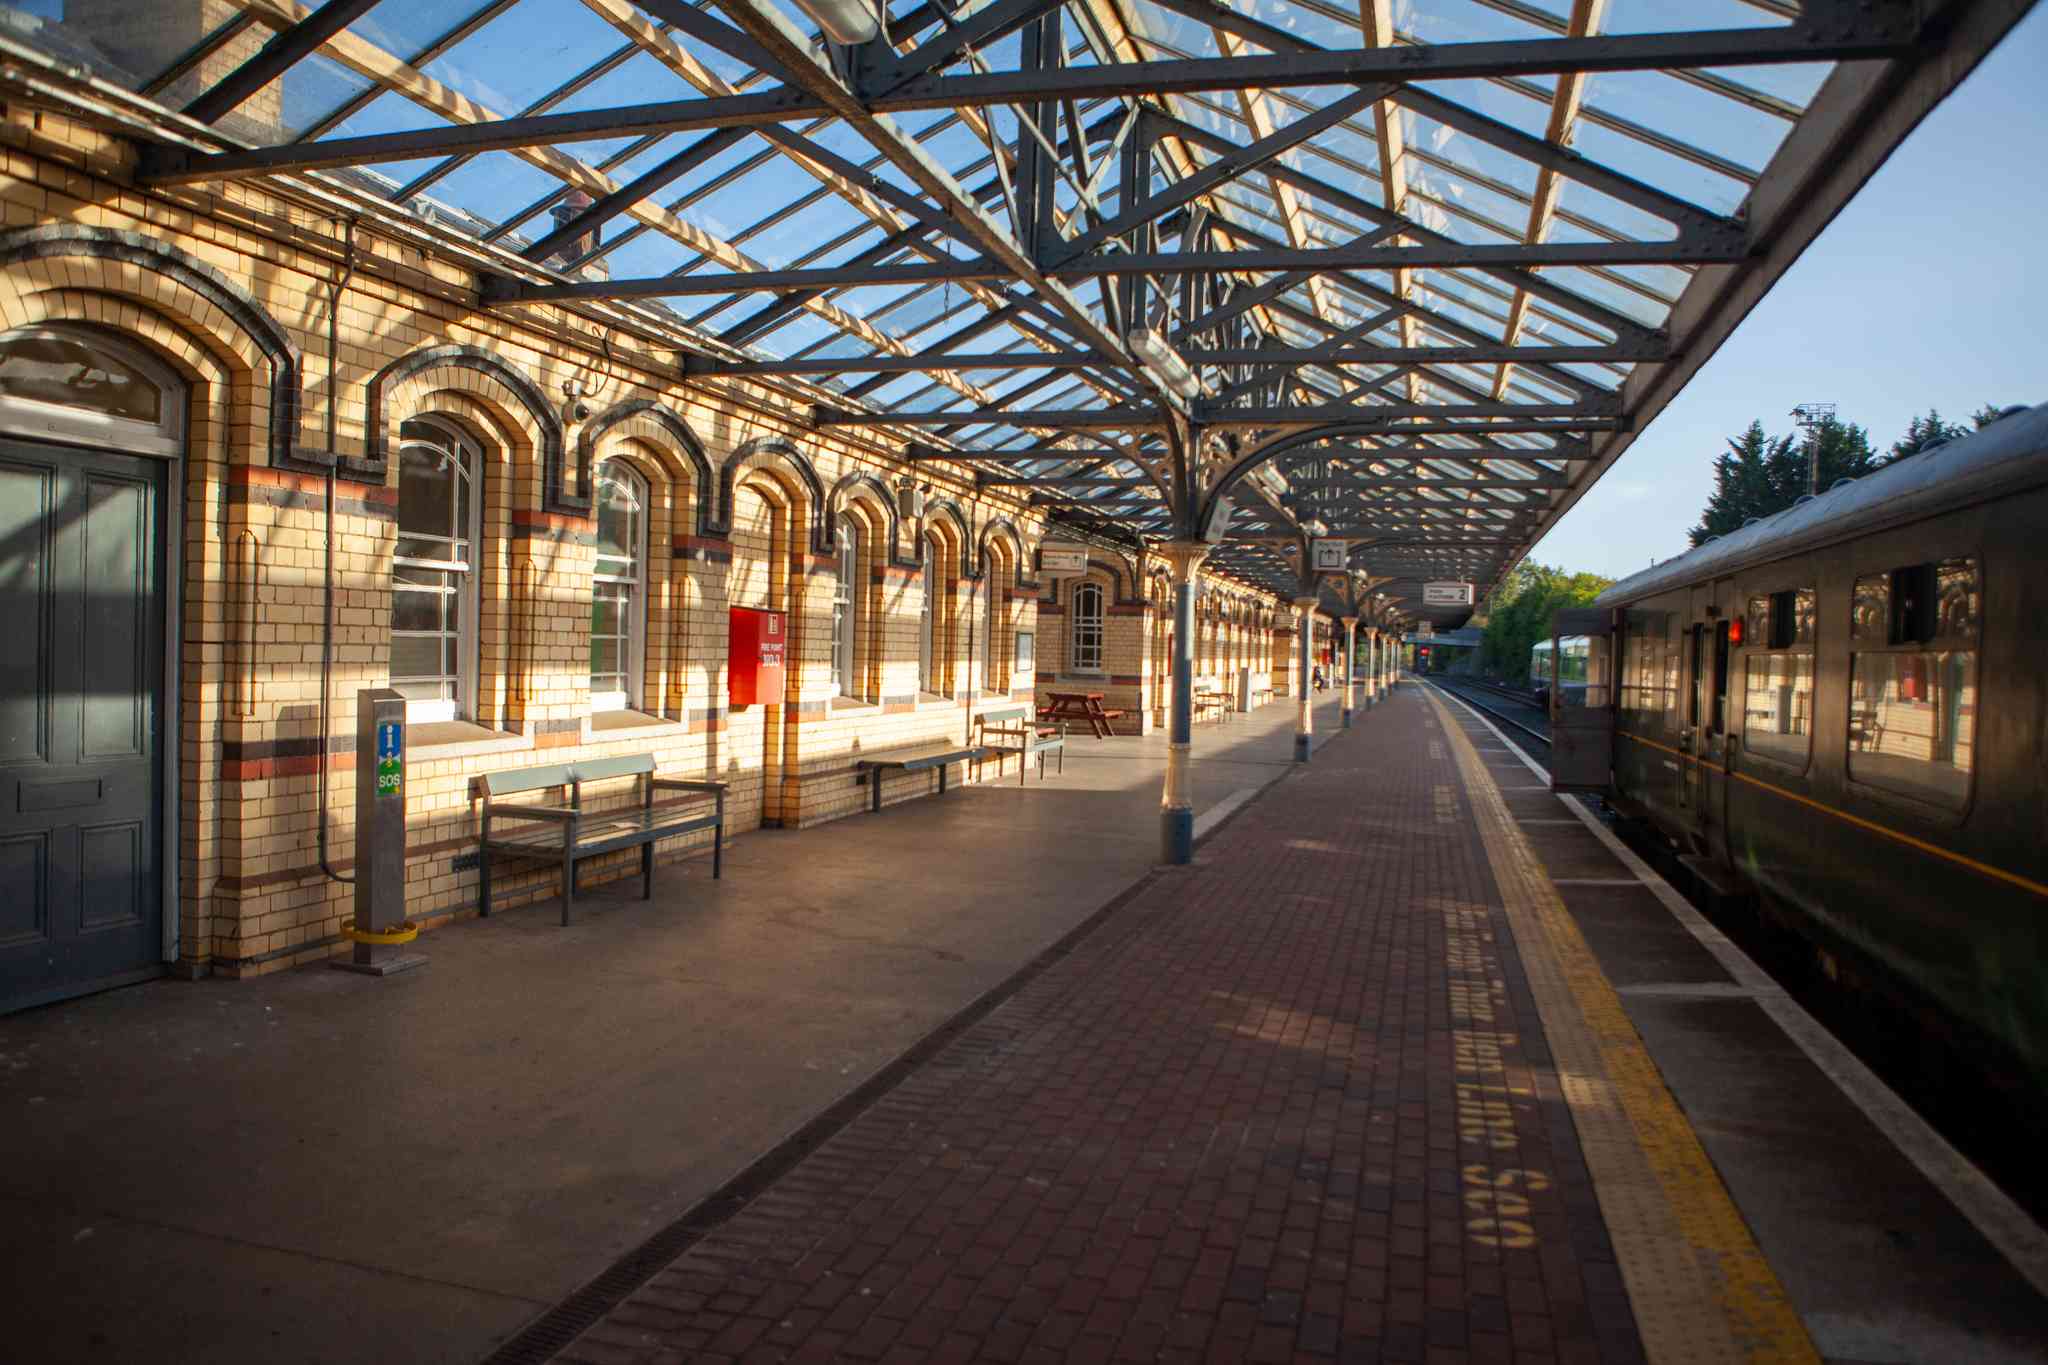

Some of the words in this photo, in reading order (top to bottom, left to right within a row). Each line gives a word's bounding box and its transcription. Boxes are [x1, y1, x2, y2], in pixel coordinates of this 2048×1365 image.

[1458, 589, 1466, 600] 2
[378, 773, 401, 788] SOS
[1462, 1164, 1550, 1248] Seo
